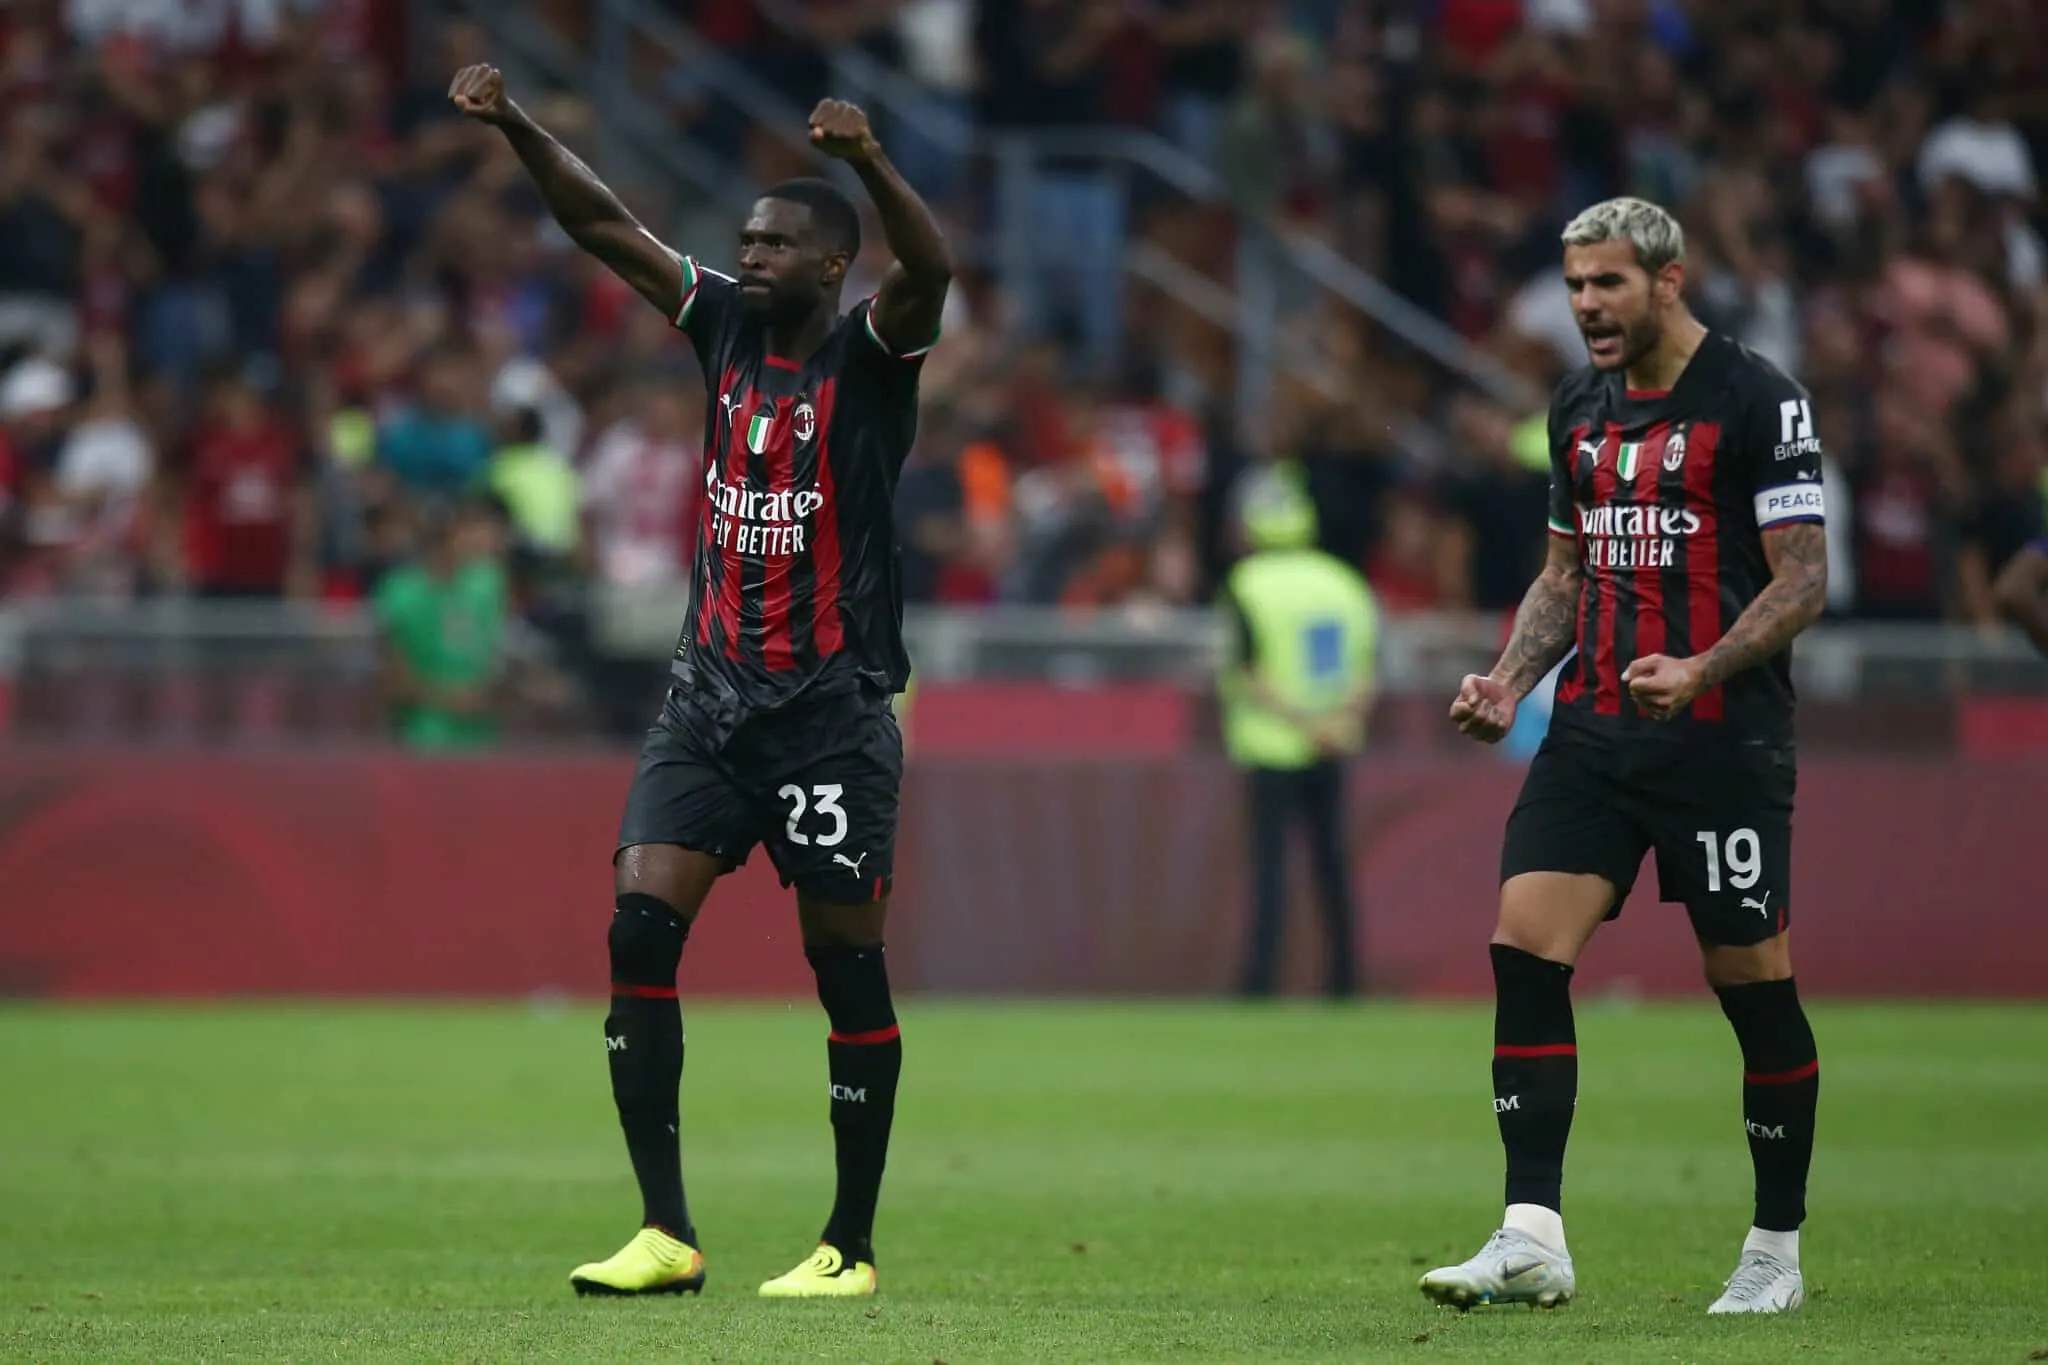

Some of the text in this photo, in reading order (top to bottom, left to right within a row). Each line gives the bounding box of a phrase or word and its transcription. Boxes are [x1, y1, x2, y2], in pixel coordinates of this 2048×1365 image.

[736, 524, 805, 556] BETTER
[777, 783, 848, 847] 23
[1696, 827, 1762, 892] 19
